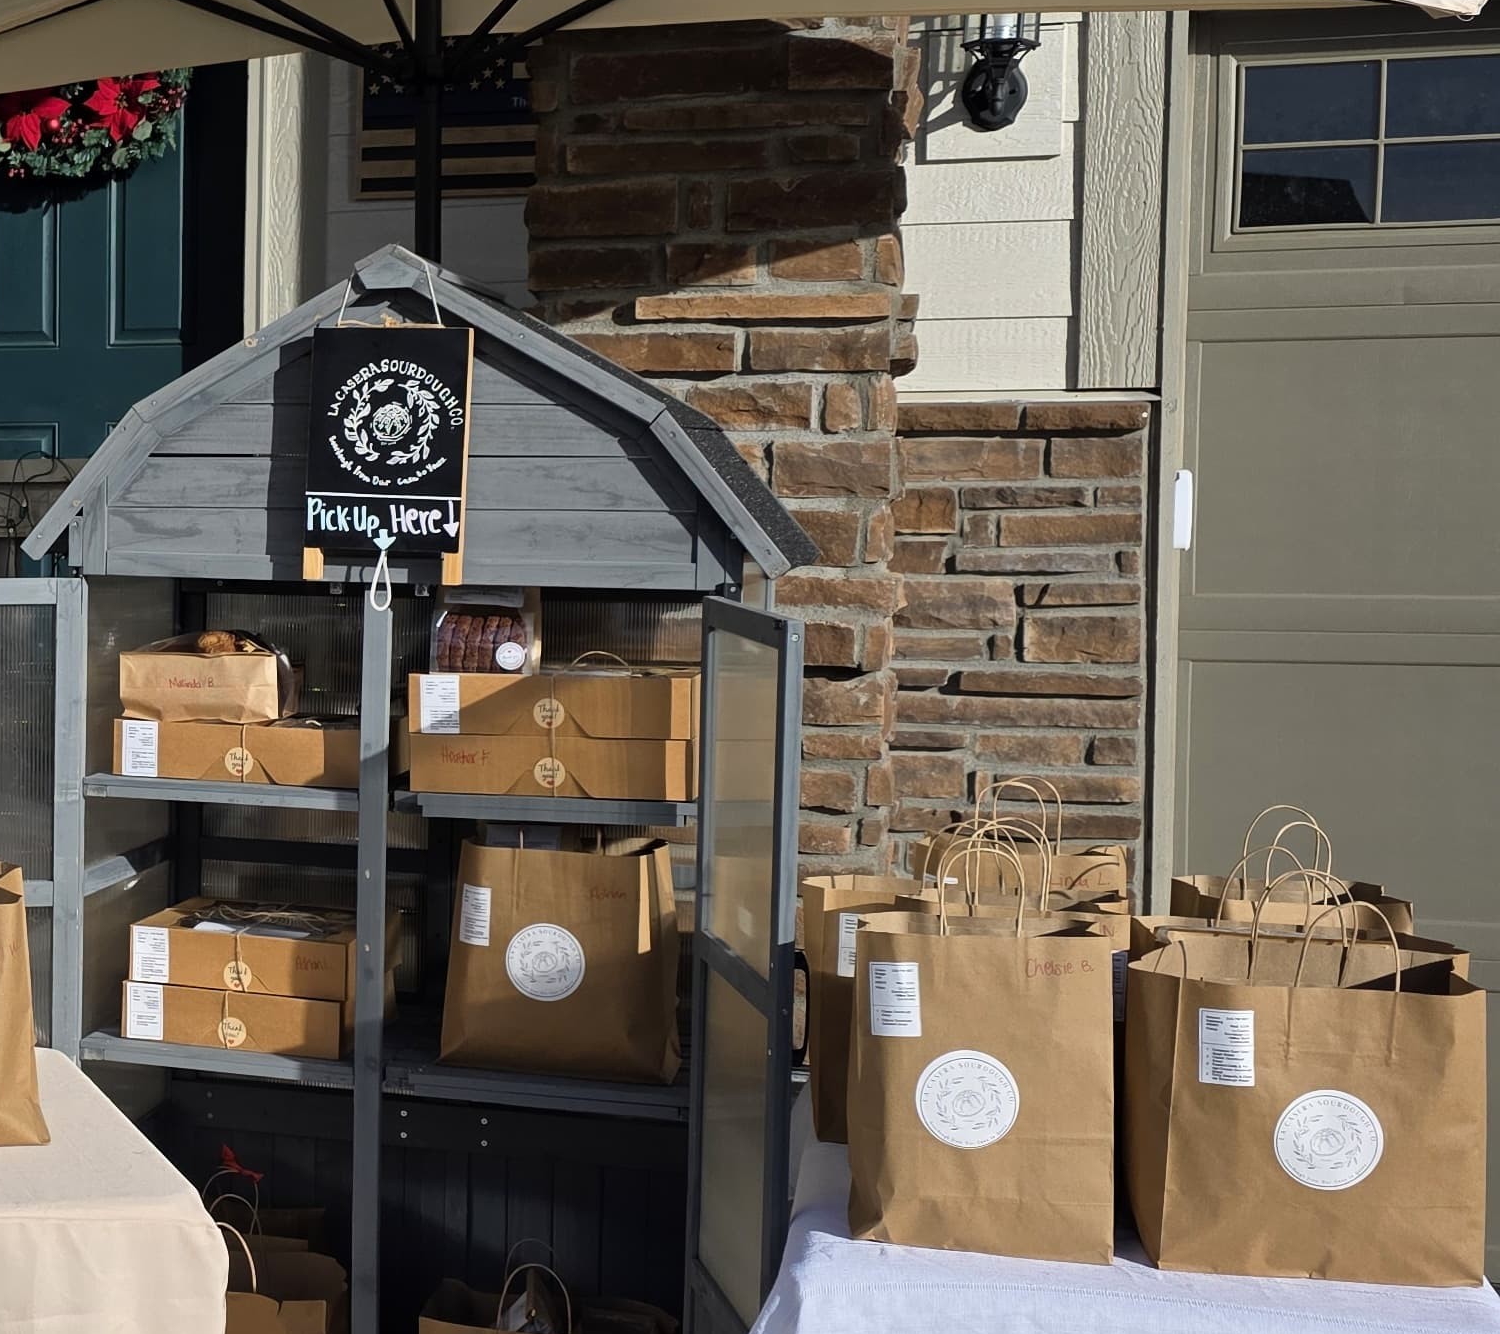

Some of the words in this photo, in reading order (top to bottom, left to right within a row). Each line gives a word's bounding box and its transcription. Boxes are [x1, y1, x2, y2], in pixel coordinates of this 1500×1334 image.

[334, 362, 382, 401] CASERA
[380, 358, 460, 410] SOURDOUGH
[327, 401, 342, 417] LA
[306, 496, 380, 538] Pick-Up
[389, 504, 443, 536] Here
[229, 752, 249, 761] Thak
[1025, 958, 1075, 978] Chelsie
